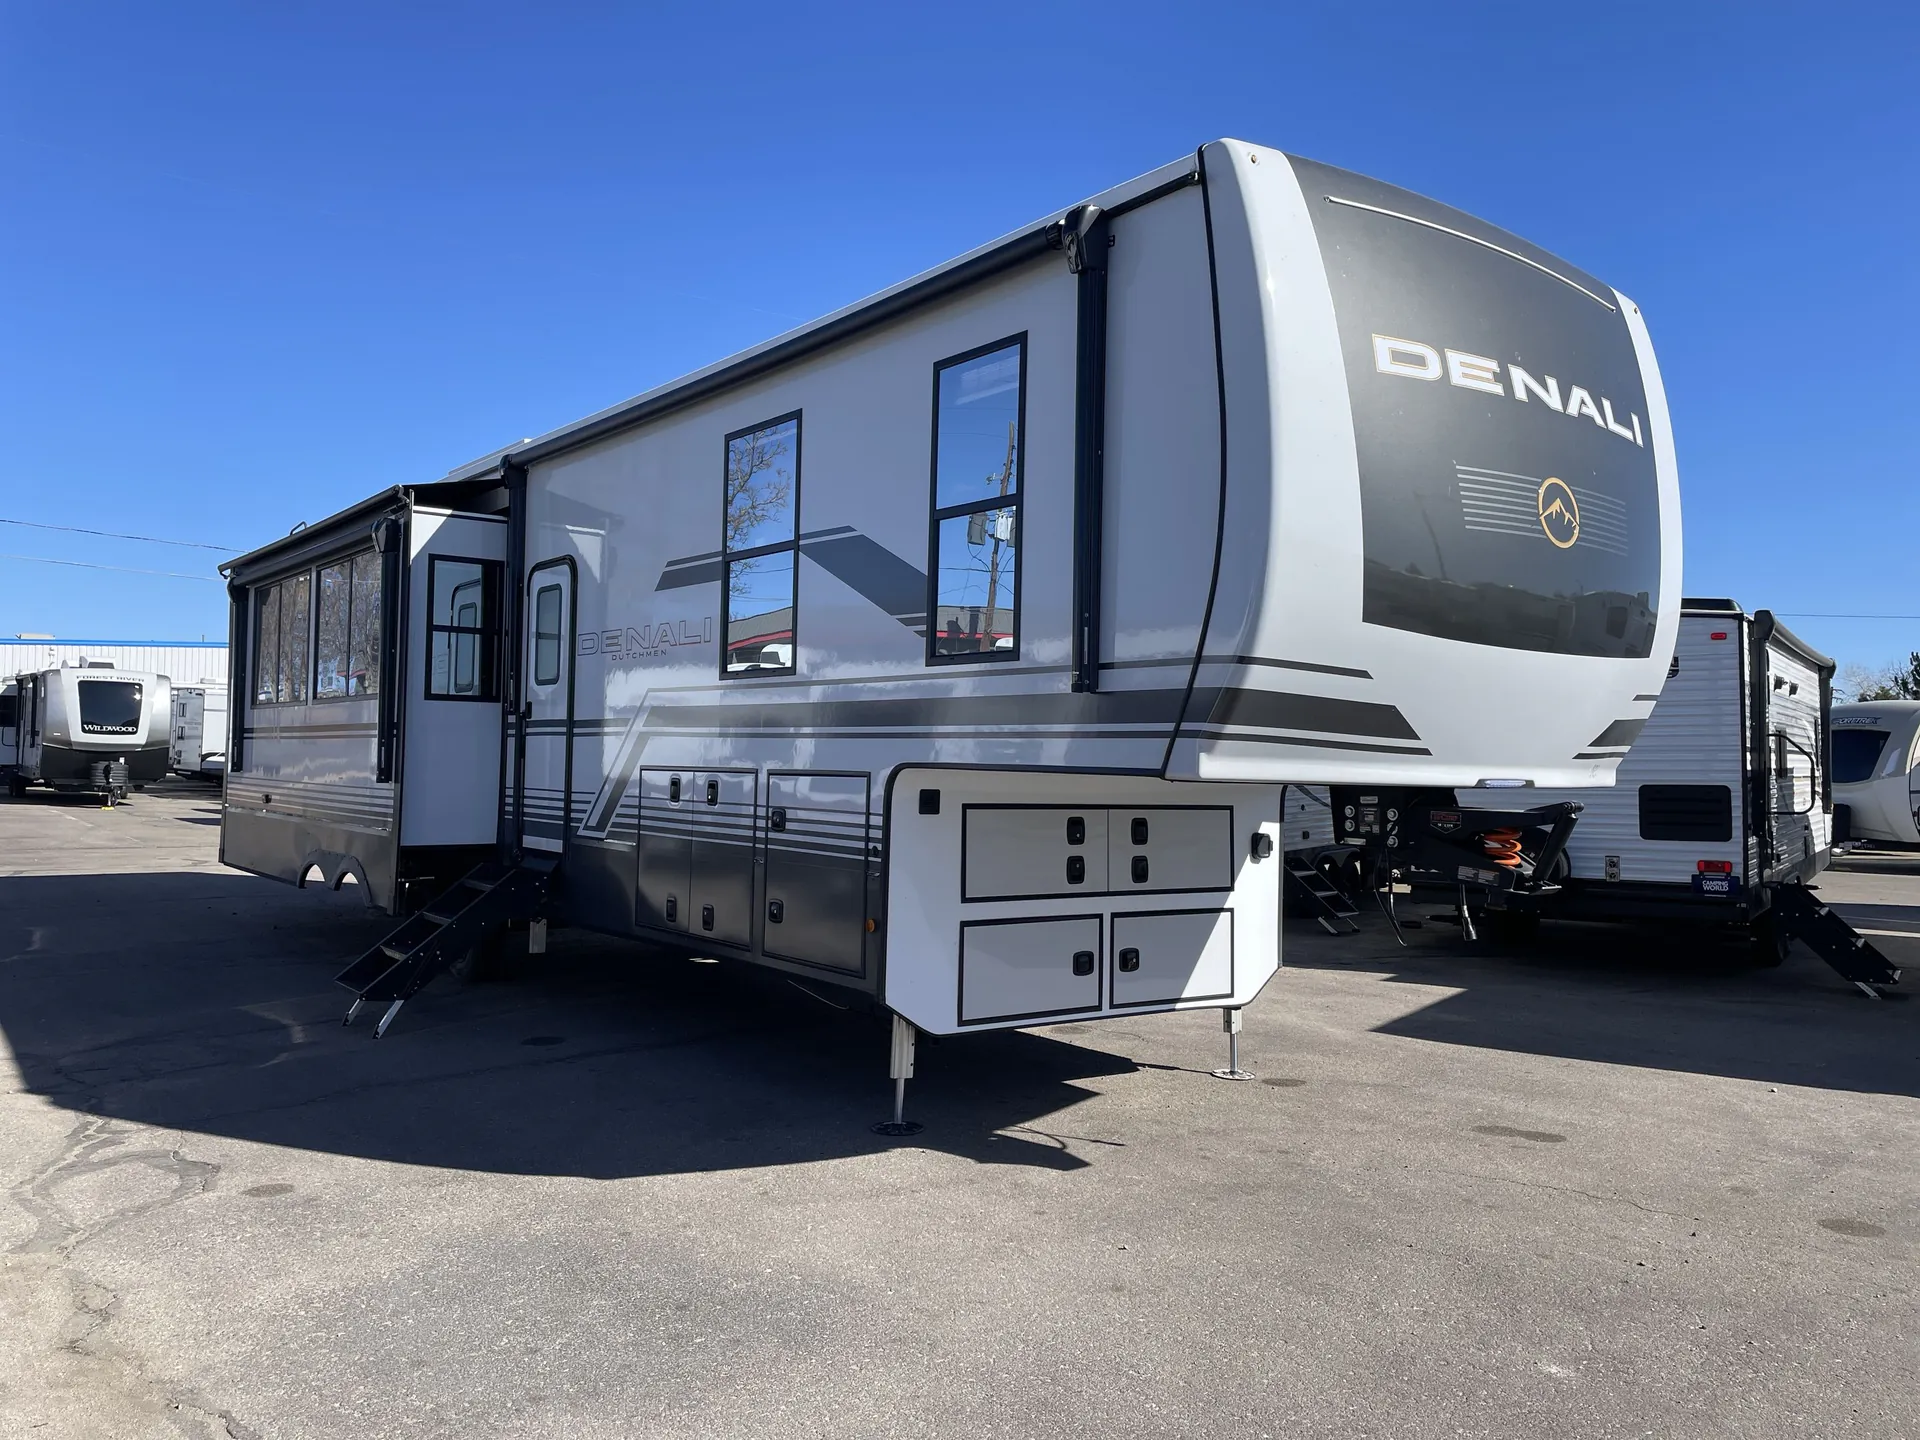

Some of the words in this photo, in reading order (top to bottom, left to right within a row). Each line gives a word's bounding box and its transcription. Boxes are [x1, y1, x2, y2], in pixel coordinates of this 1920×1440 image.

[1371, 333, 1644, 448] DENALI
[577, 616, 712, 656] DENALI
[611, 649, 667, 660] DUTCHMEN
[83, 724, 137, 732] WILDWOOD
